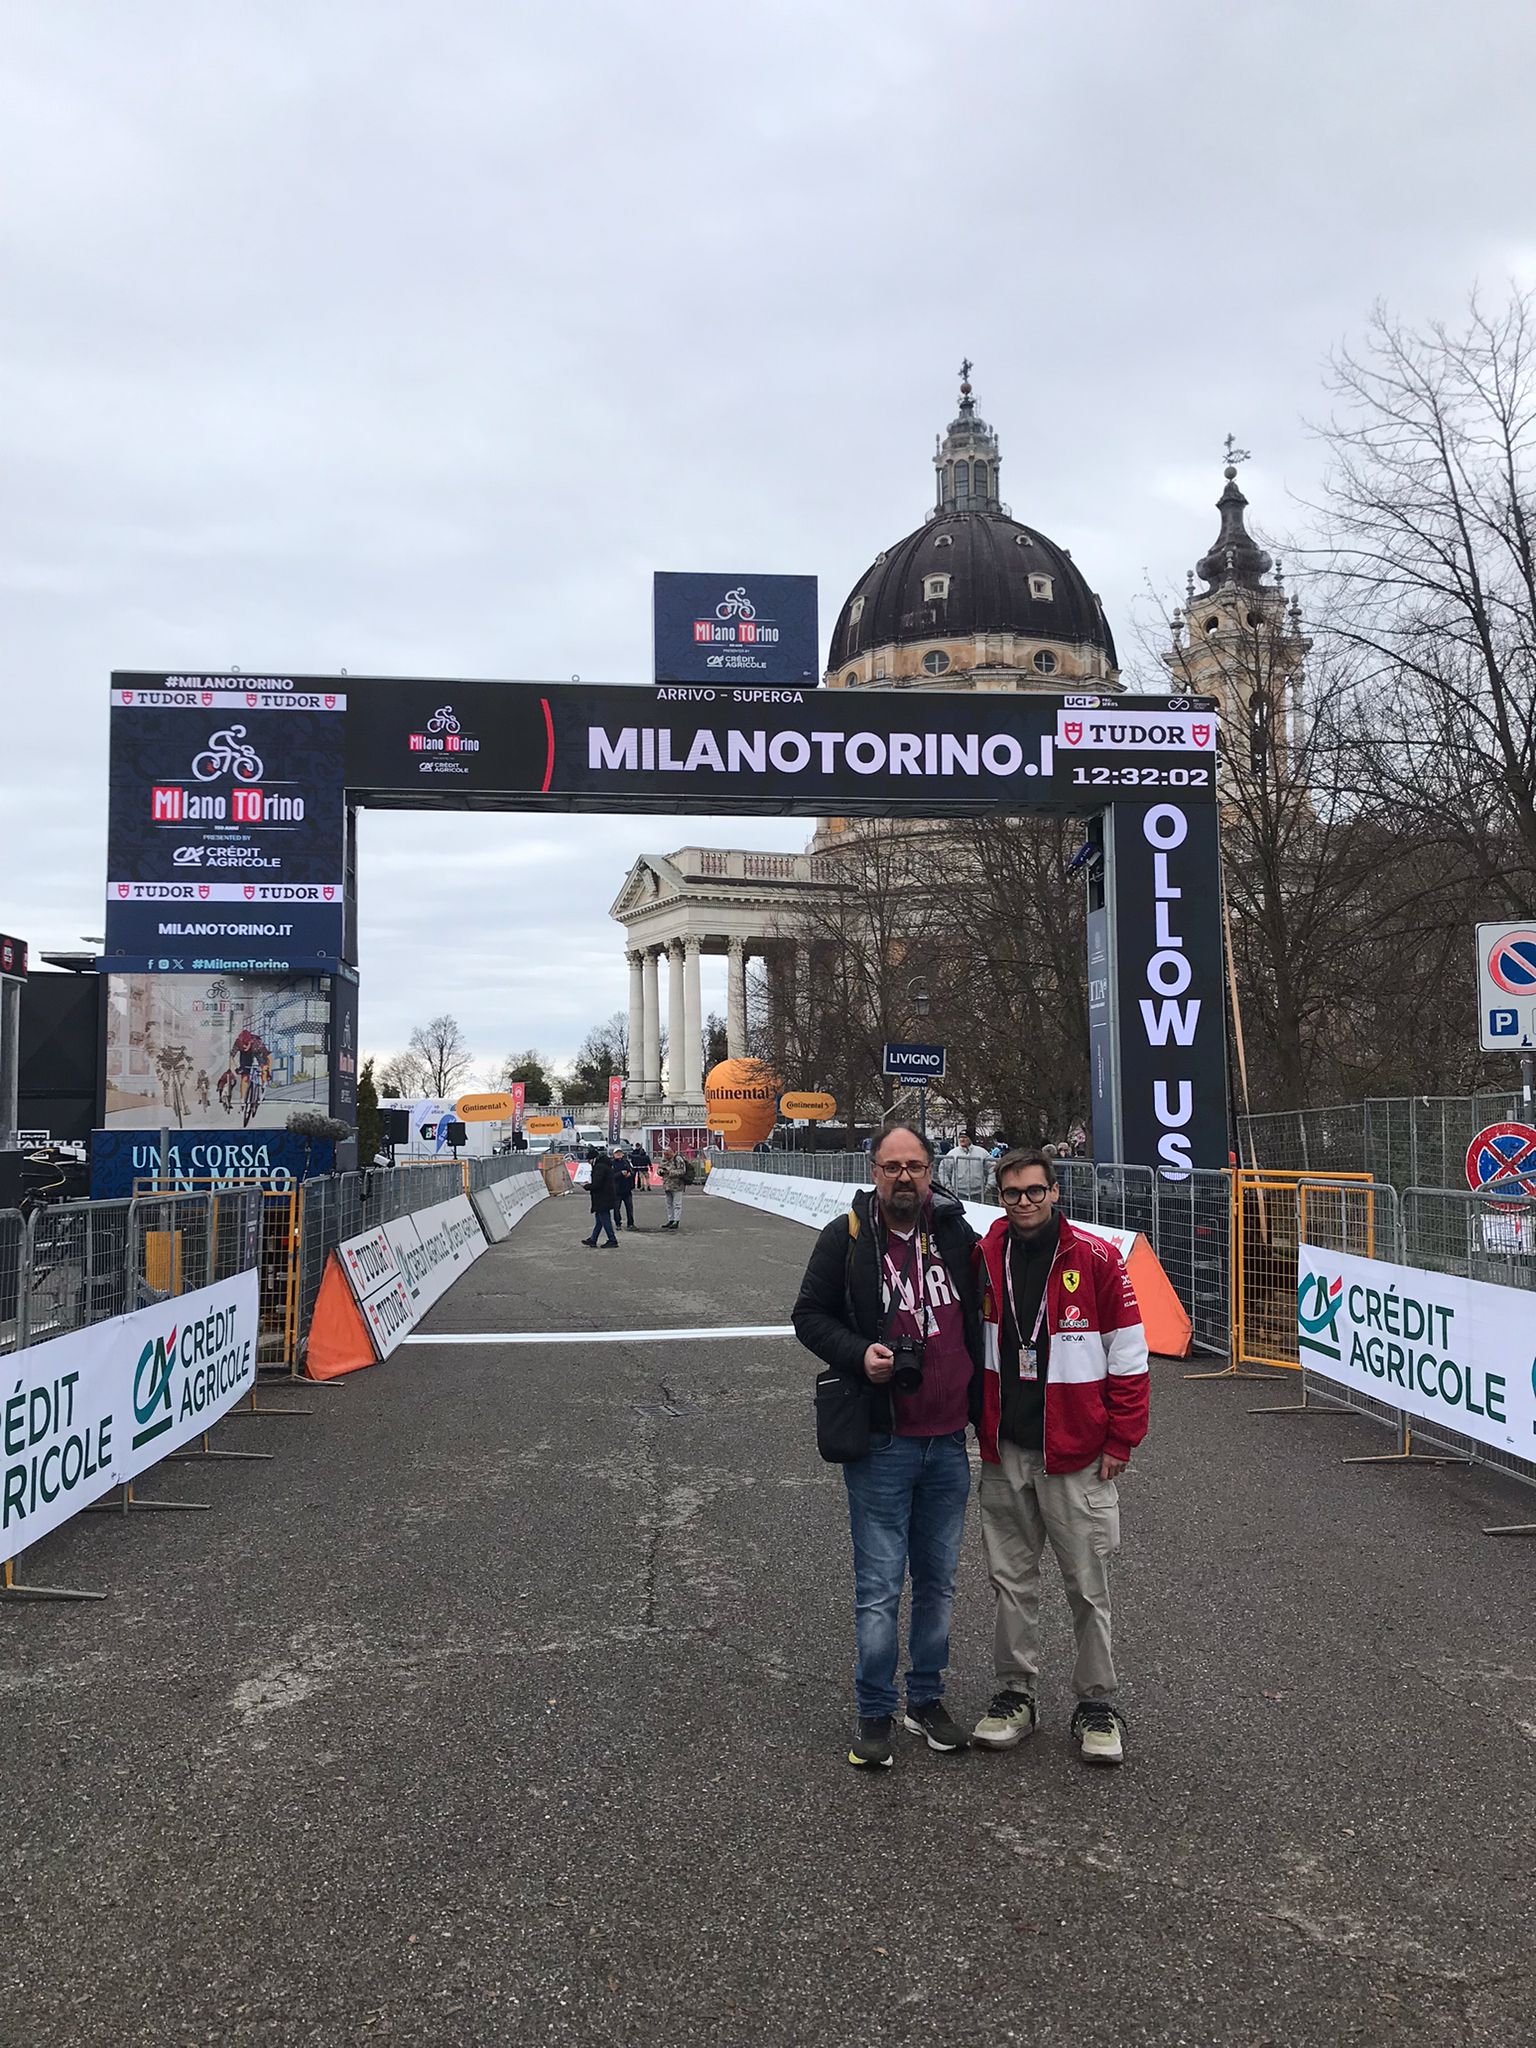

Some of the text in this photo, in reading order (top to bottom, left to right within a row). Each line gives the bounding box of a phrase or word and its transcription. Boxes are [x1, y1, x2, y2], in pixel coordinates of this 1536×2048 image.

[725, 655, 756, 663] CRÉDIT
[165, 676, 294, 691] #MILANOTORINO
[137, 692, 321, 708] TUDOR TUDOR
[657, 688, 716, 701] ARRIVO
[733, 690, 804, 704] SUPERGA
[1066, 697, 1087, 706] UCI
[1089, 724, 1186, 744] TUDOR
[588, 727, 1058, 776] MILANOTORINO.I
[1072, 767, 1209, 786] 12:32:02
[206, 845, 261, 857] CRÉDIT
[206, 857, 282, 868] AGRICOLE
[133, 885, 319, 899] TUDOR TUDOR
[158, 923, 294, 936] MILANOTORINO.IT
[1138, 803, 1201, 1046] OLLOW
[191, 958, 290, 970] #MilanoTorino
[889, 1052, 941, 1066] LIVIGNO
[900, 1076, 927, 1084] LIVIGNO
[705, 1085, 770, 1103] ontinental
[462, 1102, 502, 1114] Continental
[786, 1100, 824, 1109] Continental
[1153, 1080, 1194, 1181] US
[132, 1144, 271, 1168] UNA CORSA
[209, 1166, 291, 1193] MITO
[355, 1240, 390, 1283] TUDOR
[375, 1289, 409, 1337] TUDOR
[1348, 1284, 1455, 1350] CRÉDIT
[180, 1305, 237, 1369] CRÉDIT
[179, 1340, 250, 1423] AGRICOLE
[1349, 1331, 1507, 1424] AGRICOLE
[0, 1371, 79, 1457] ÉDIT
[3, 1414, 113, 1530] RICOLE
